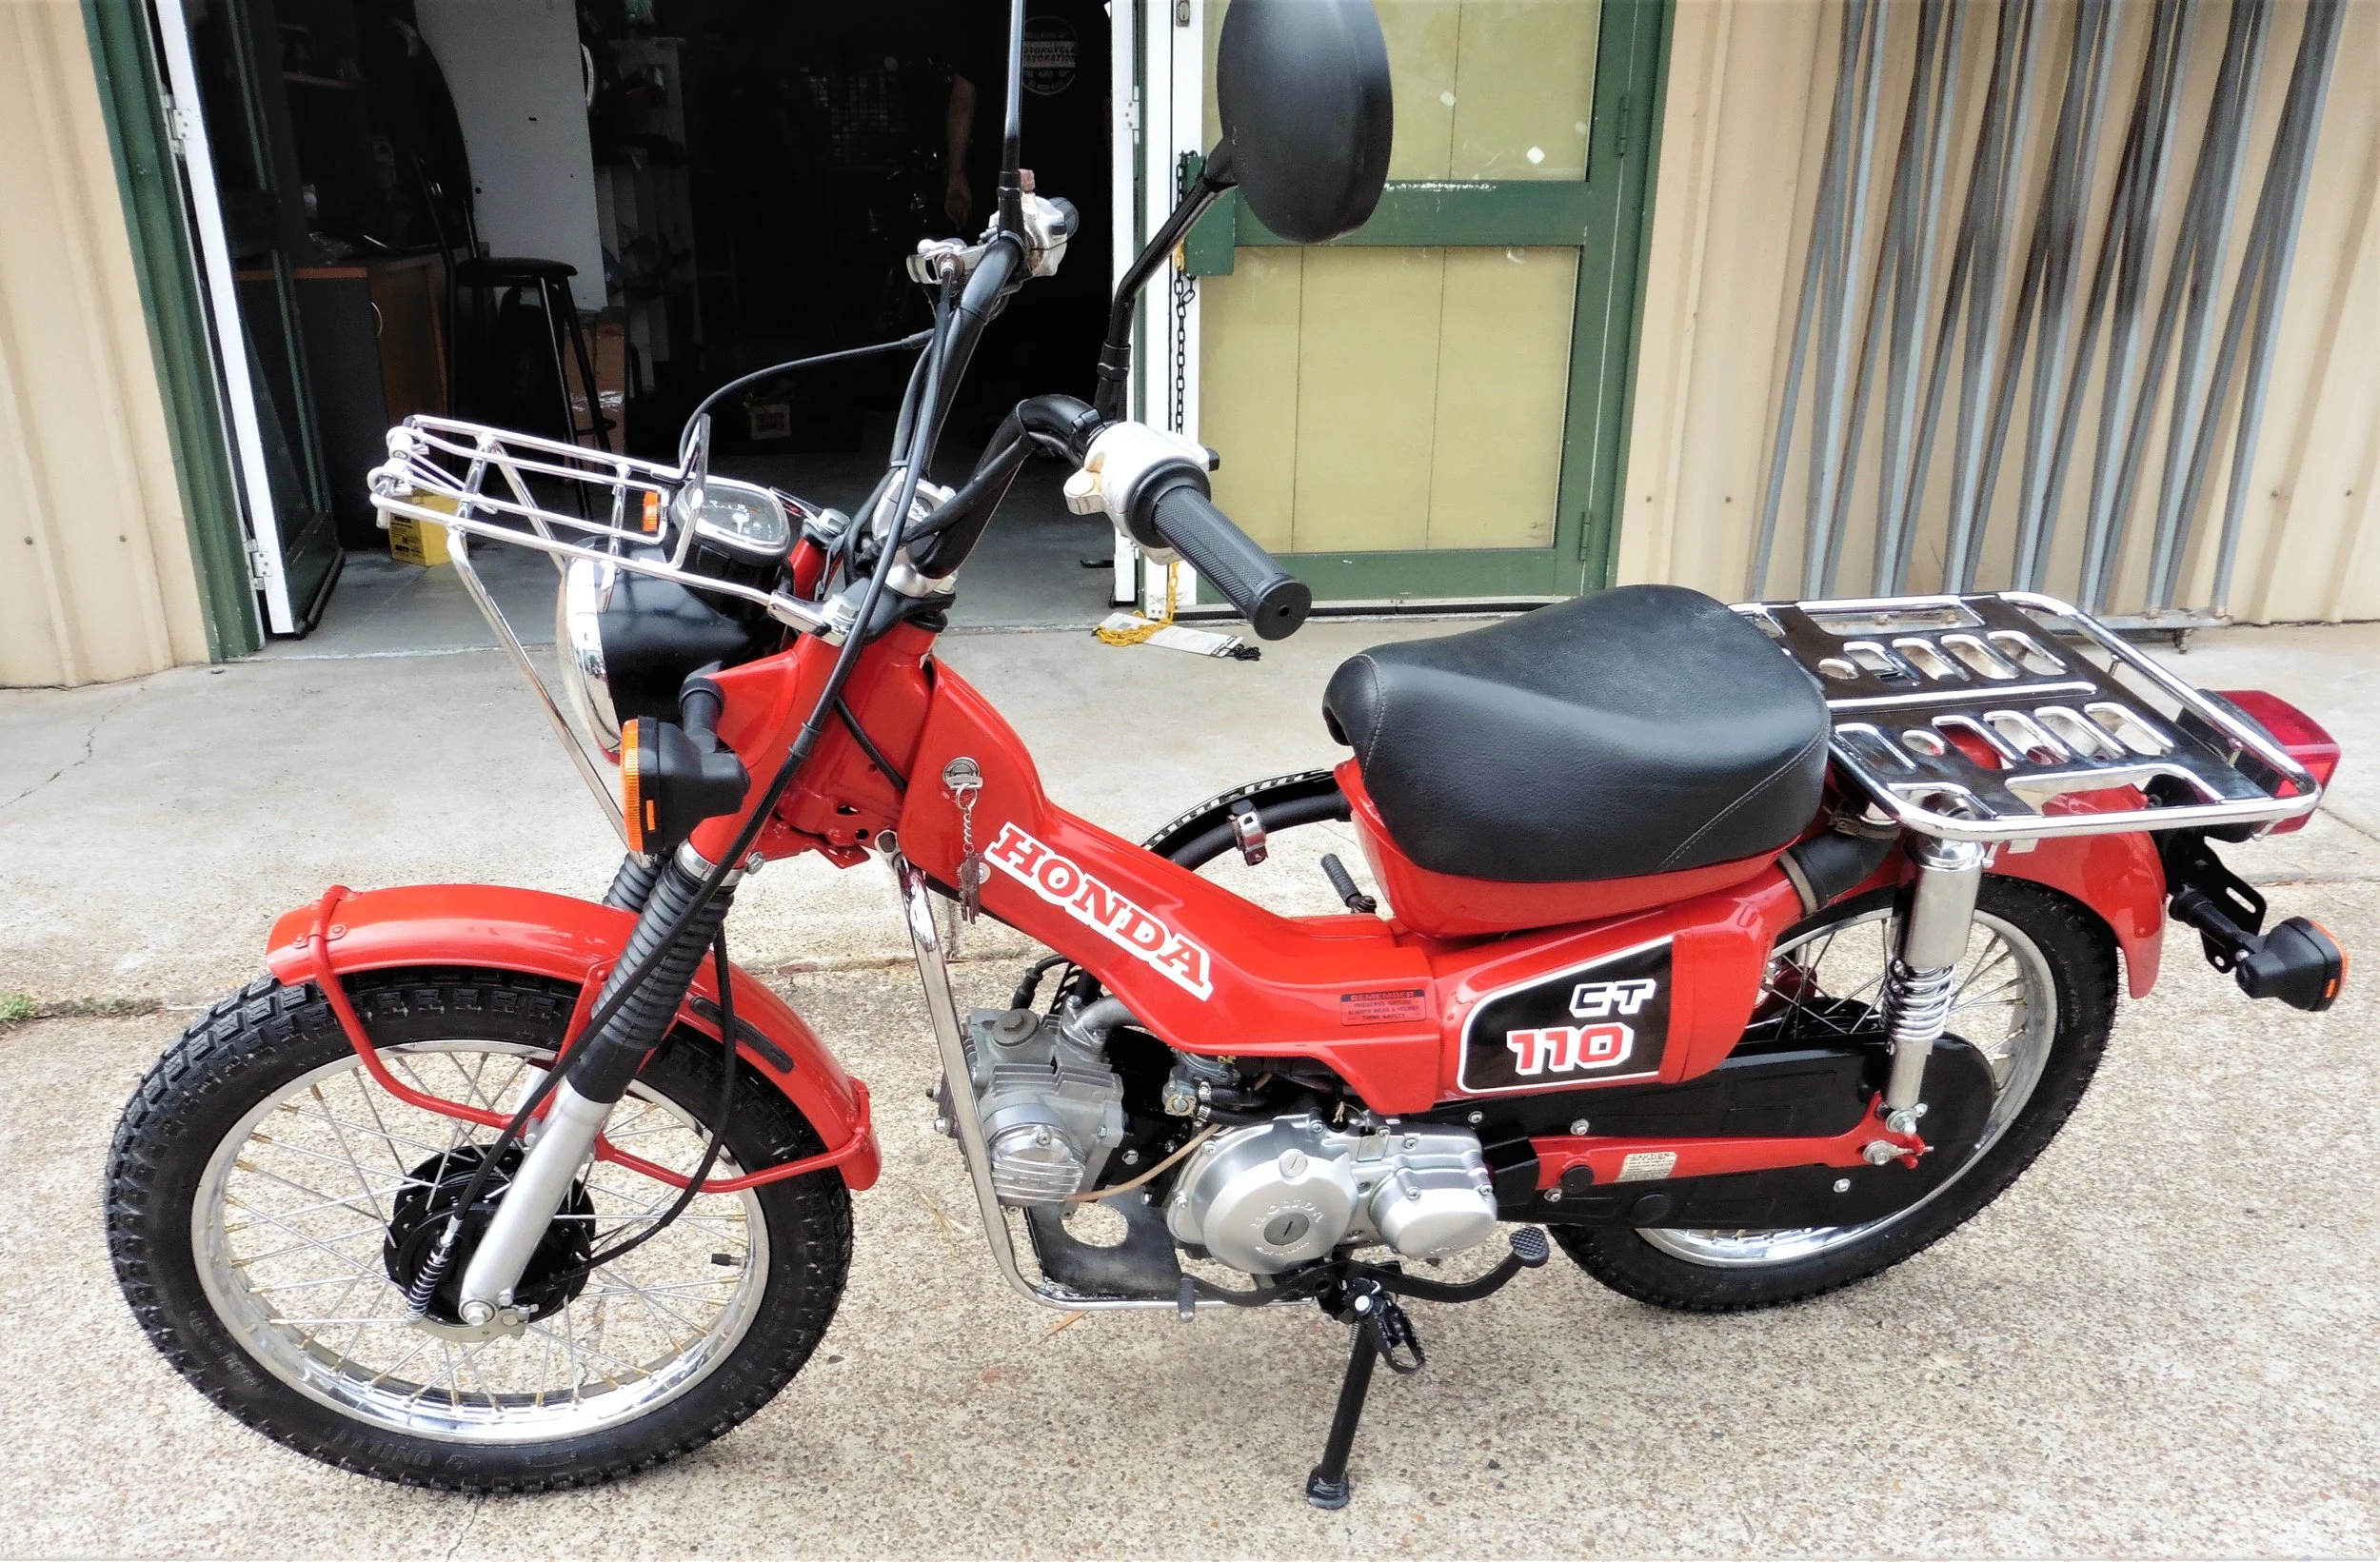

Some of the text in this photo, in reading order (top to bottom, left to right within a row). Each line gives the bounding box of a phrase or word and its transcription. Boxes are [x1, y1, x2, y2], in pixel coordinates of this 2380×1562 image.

[984, 822, 1212, 1000] HONDA
[1351, 991, 1415, 1001] REMEMBER
[1570, 979, 1656, 1018] CT
[1507, 1022, 1634, 1076] 110
